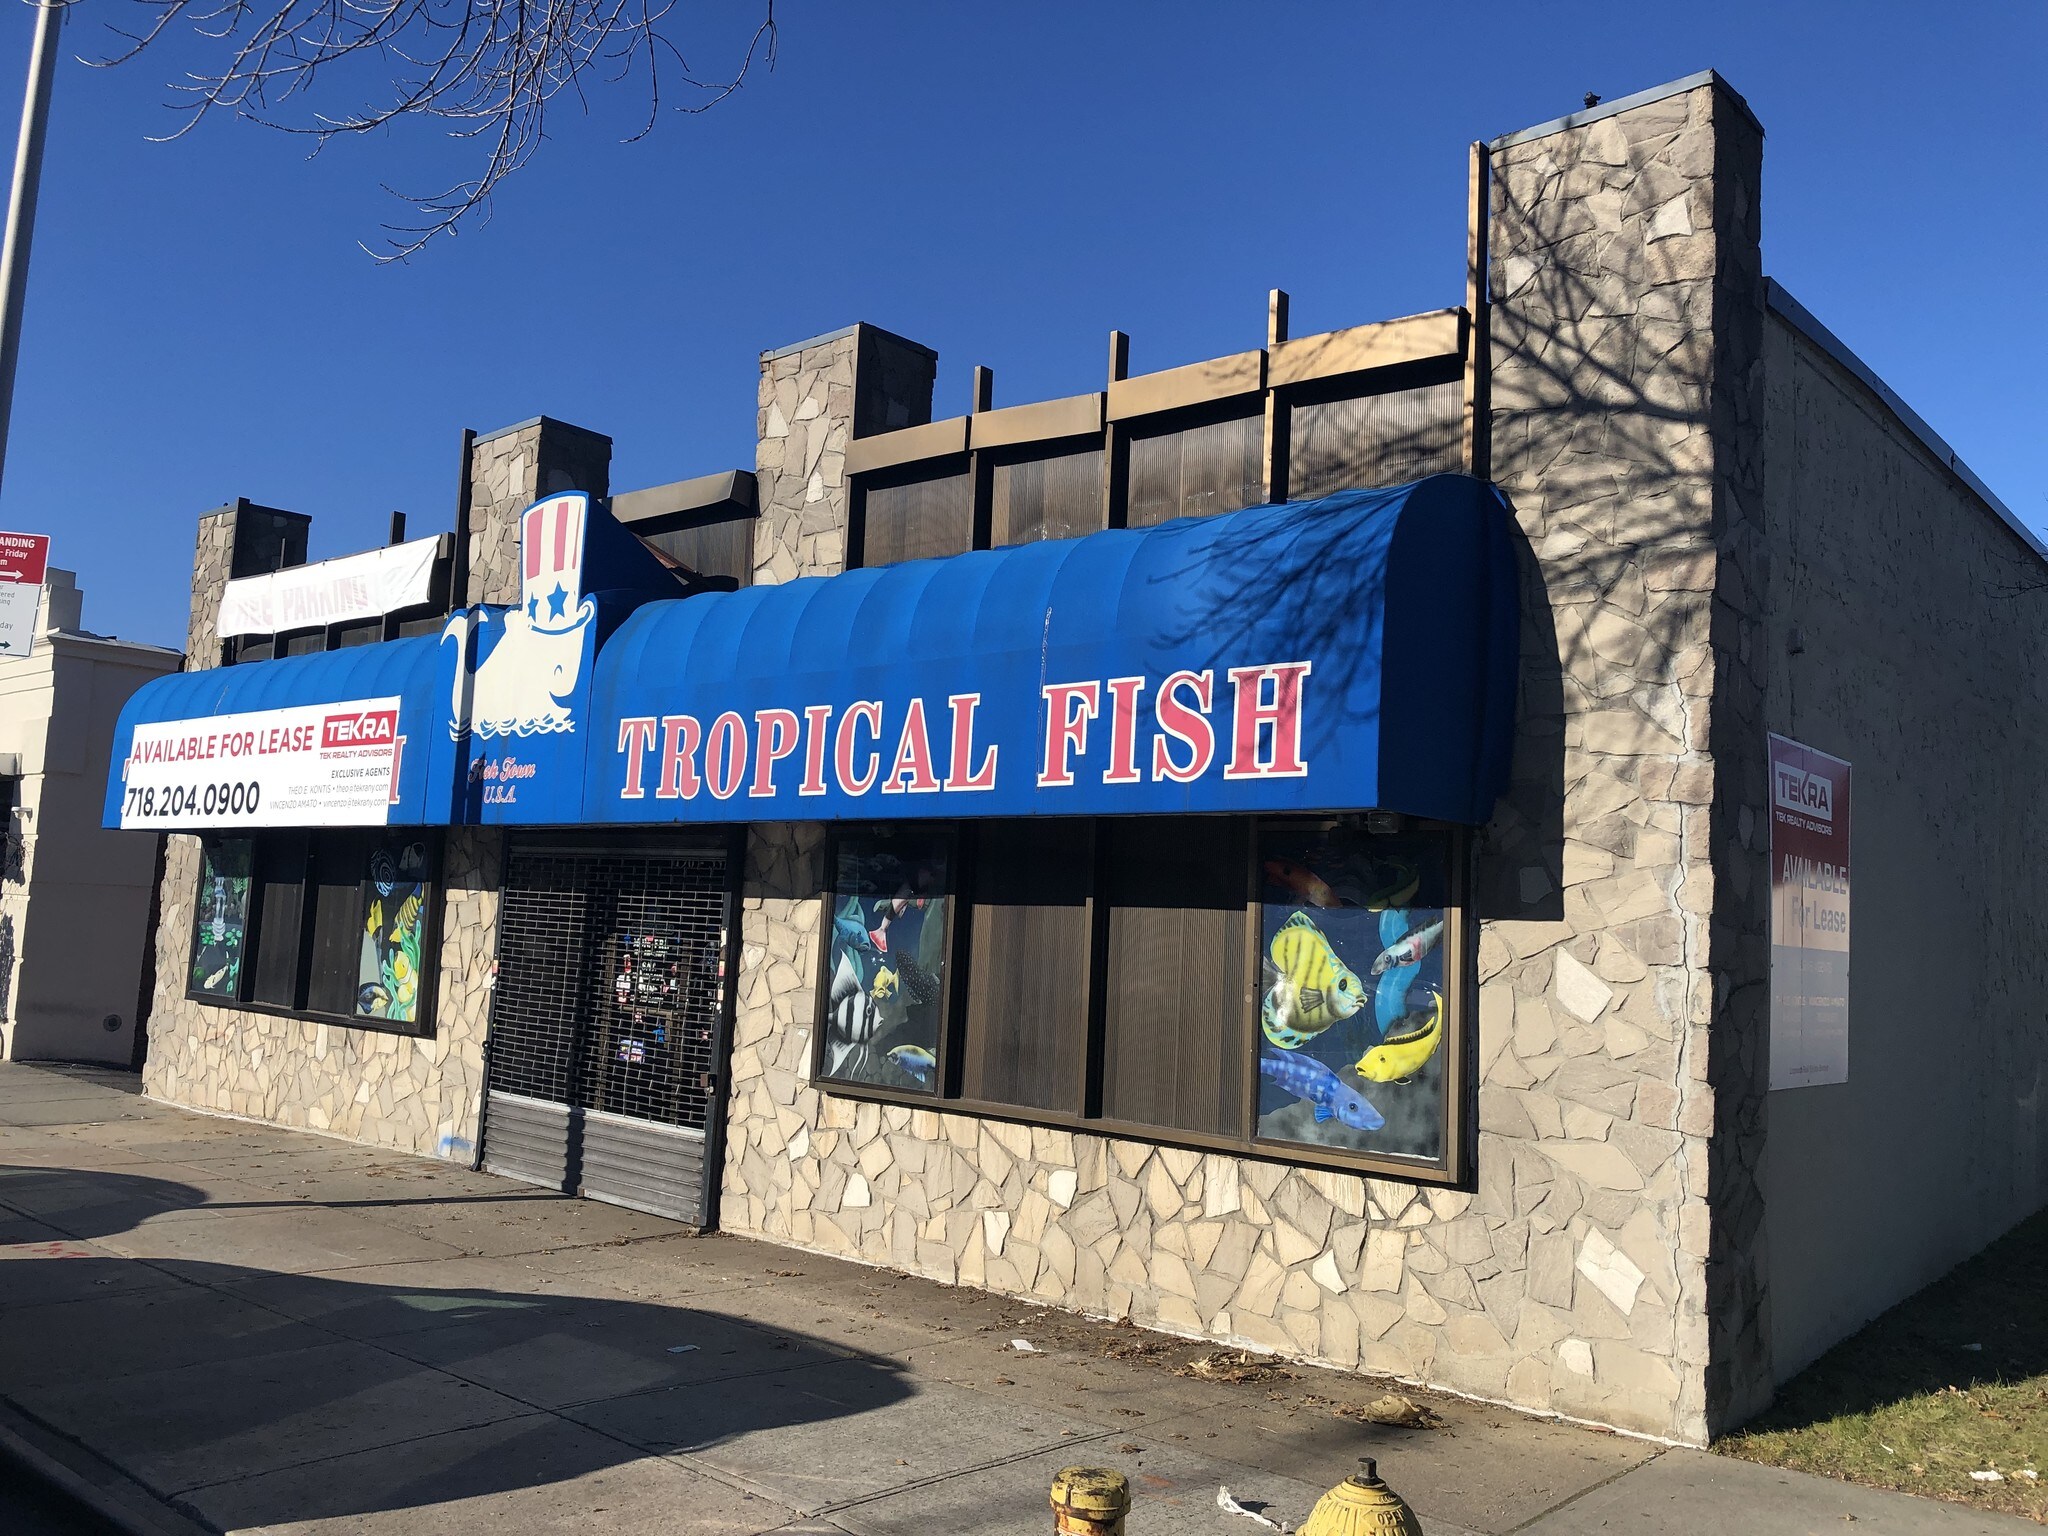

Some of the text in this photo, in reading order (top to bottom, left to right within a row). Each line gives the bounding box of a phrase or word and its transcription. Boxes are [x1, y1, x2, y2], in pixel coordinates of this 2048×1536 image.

[5, 549, 28, 559] Friday
[326, 713, 391, 742] TEKRA
[617, 661, 1311, 800] TROPICAL FISH
[132, 725, 314, 764] AVAILABLE FOR LEASE
[332, 750, 357, 759] REALTY
[358, 748, 393, 757] ADVISORS
[331, 767, 390, 778] EXCLUSIVE AGENTS
[500, 757, 536, 782] Town
[125, 781, 260, 817] 718.204.0900
[288, 786, 303, 795] THEO
[484, 785, 517, 804] U.S.A.
[1778, 771, 1829, 812] TEKRA
[270, 800, 297, 809] VINCENZO
[297, 799, 317, 808] AMATO
[1775, 811, 1833, 836] TEK REALTY ADVISORS
[1782, 853, 1847, 895] AVAILABLE
[1791, 896, 1847, 933] For Lease
